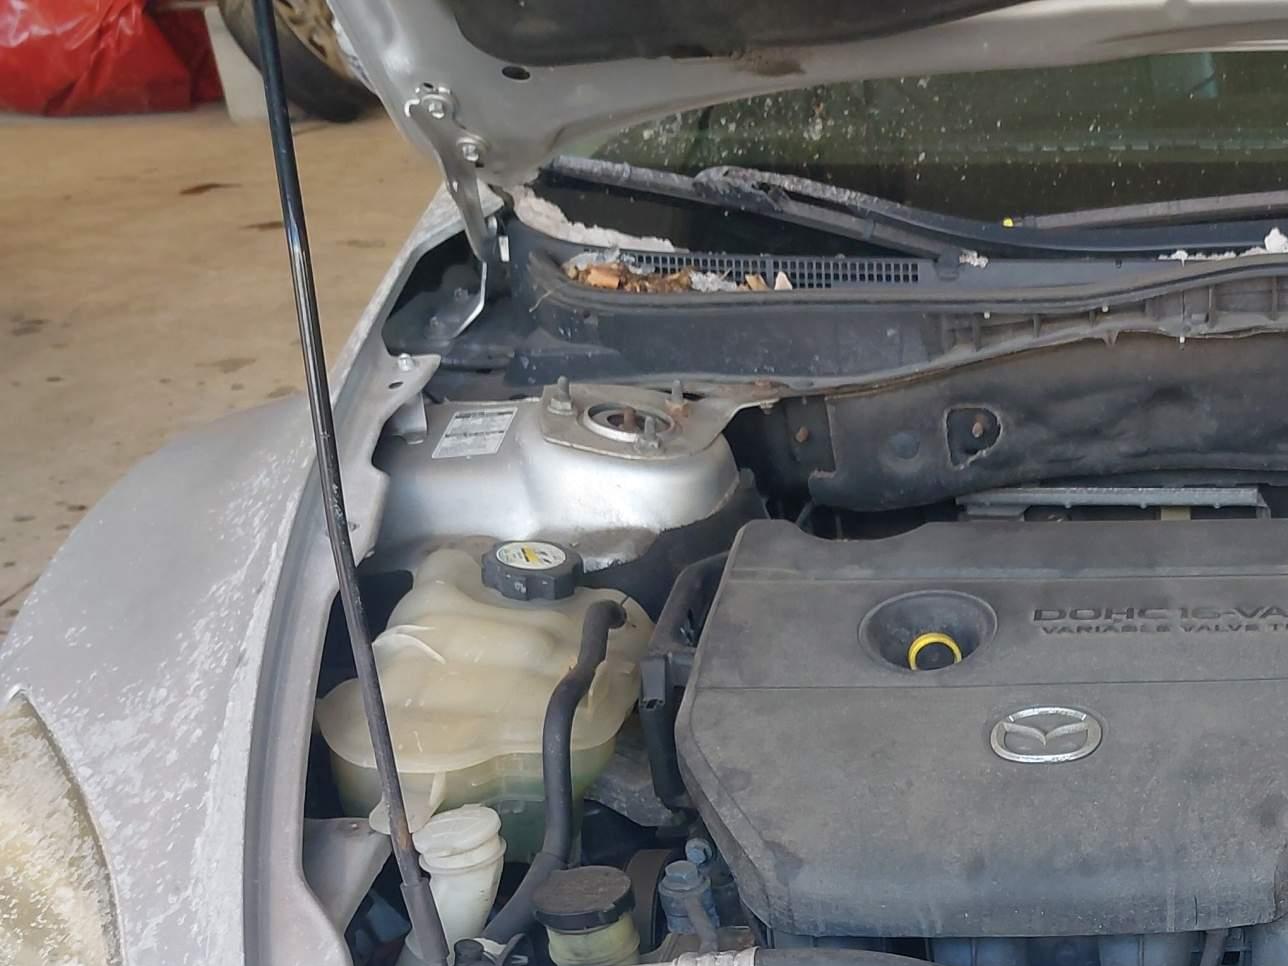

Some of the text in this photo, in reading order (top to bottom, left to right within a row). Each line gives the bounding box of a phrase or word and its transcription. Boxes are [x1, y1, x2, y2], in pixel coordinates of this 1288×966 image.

[1033, 606, 1168, 622] DOHC
[1041, 624, 1171, 635] VARIABLE
[1183, 623, 1260, 633] VALVE
